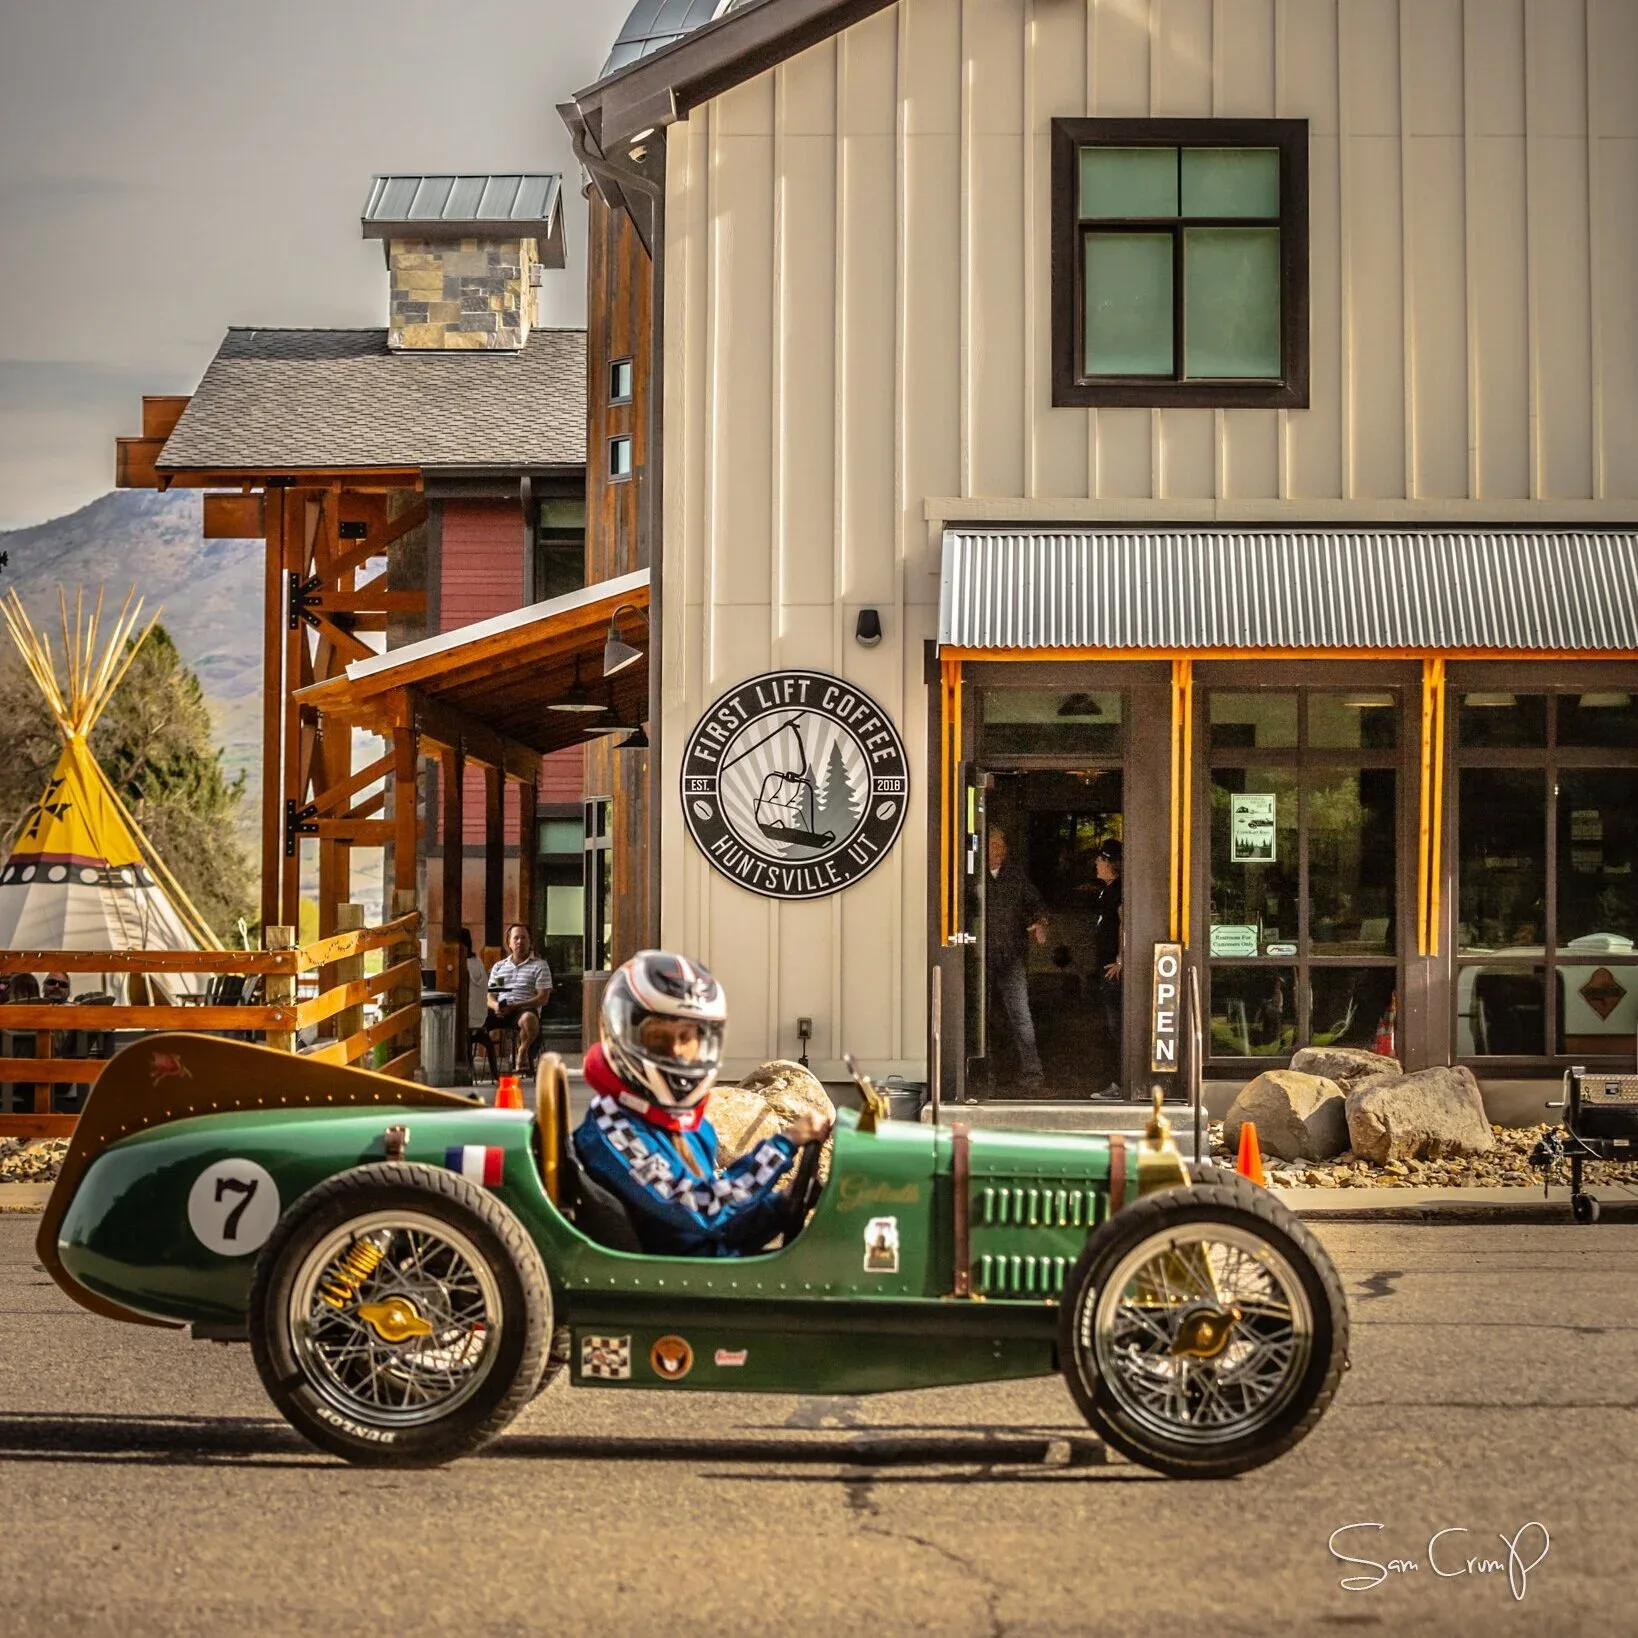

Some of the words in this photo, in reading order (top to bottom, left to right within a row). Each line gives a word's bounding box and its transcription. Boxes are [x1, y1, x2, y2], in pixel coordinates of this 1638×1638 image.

[694, 697, 748, 763] FIRST
[756, 680, 811, 709] LIFT
[822, 686, 896, 764] COFFEE
[691, 779, 710, 791] EST.
[877, 779, 901, 791] 2018
[710, 834, 850, 892] HUNTSVILLE,
[848, 833, 878, 865] UT
[1156, 955, 1178, 1061] OPEN
[214, 1177, 259, 1241] 7
[316, 1407, 397, 1443] DUNLOP
